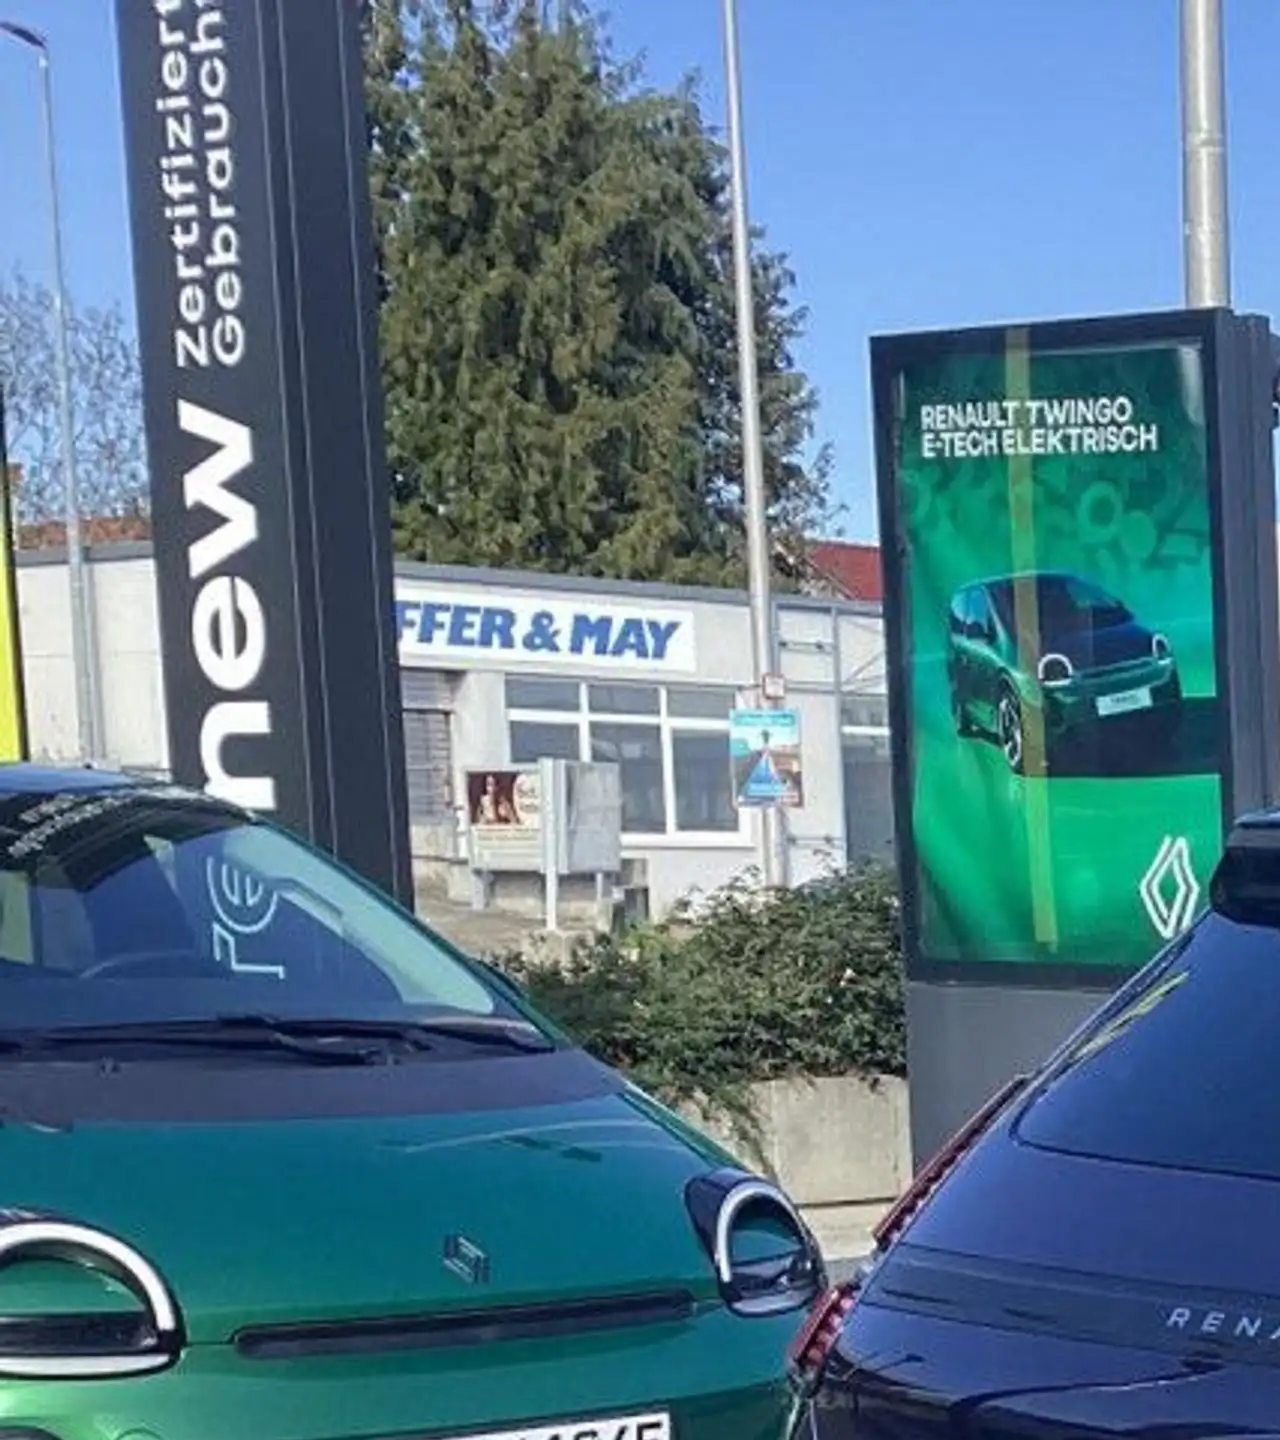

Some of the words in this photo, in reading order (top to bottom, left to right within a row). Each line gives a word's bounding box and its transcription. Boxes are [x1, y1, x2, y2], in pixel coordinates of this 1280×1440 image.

[189, 0, 245, 366] Gebrauch
[921, 401, 1019, 430] RENAULT
[1025, 396, 1133, 424] TWINGO
[922, 431, 997, 458] E-TECH
[1002, 423, 1157, 454] ELEKTRISCH
[176, 398, 277, 811] new
[522, 610, 561, 653] &
[570, 613, 681, 660] MAY
